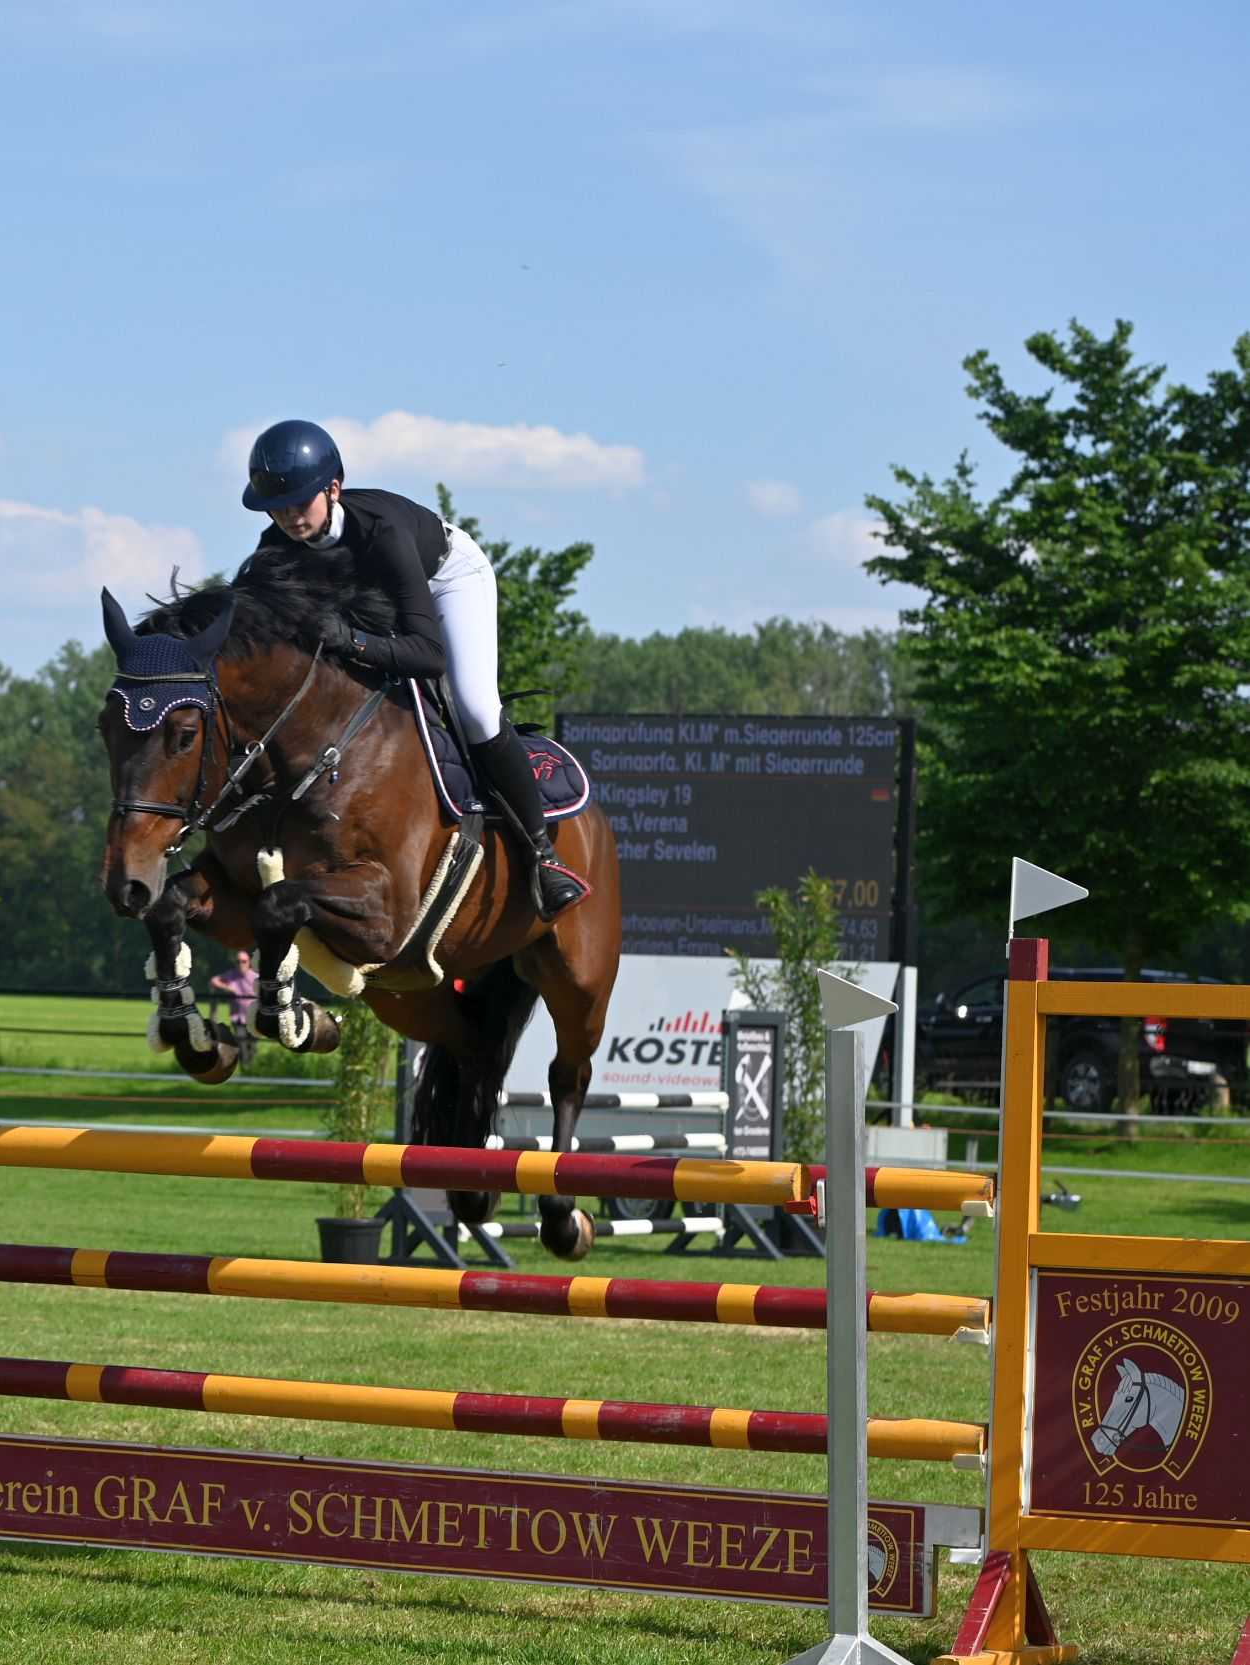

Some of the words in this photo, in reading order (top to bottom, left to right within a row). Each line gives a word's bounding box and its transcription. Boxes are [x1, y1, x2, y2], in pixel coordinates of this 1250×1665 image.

[674, 784, 692, 805] 19
[607, 811, 688, 834] ns,Verena
[615, 839, 650, 860] cher
[829, 879, 878, 907] 7.00
[607, 1035, 723, 1066] KOSTE
[603, 1071, 720, 1086] sound-videow
[1054, 1284, 1165, 1318] Festjahr
[1171, 1287, 1240, 1325] 2009
[1079, 1346, 1103, 1390] GRAF
[1121, 1324, 1204, 1382] SCHMETTOW
[1185, 1389, 1206, 1441] WEEZE
[1083, 1482, 1124, 1506] 125
[1133, 1485, 1198, 1511] Jahre
[94, 1475, 226, 1526] GRAF
[238, 1499, 271, 1532] v.
[287, 1489, 619, 1560] SCHMETTOW
[632, 1516, 815, 1576] WEEZE
